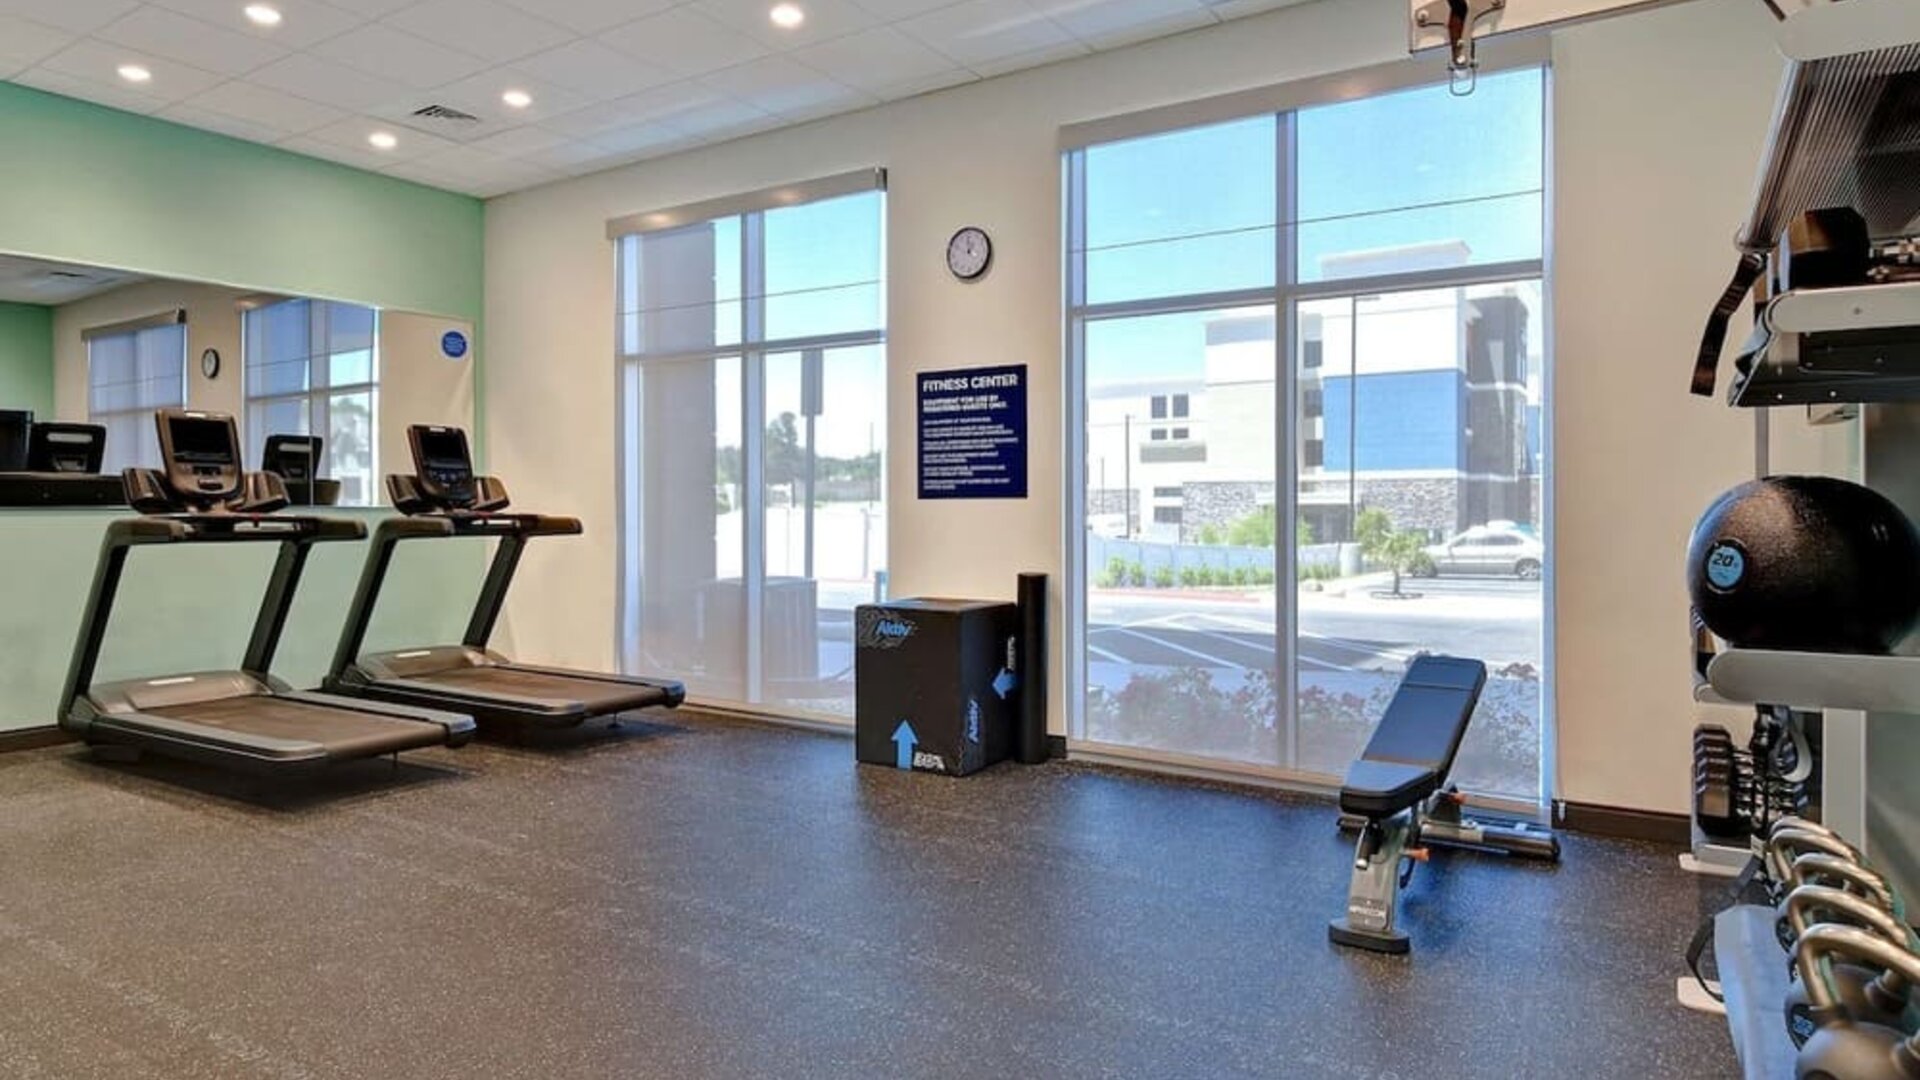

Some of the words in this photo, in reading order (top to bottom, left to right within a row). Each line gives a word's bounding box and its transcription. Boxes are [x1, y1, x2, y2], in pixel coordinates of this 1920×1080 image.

[923, 378, 968, 392] FITNESS
[971, 374, 1018, 388] CENTER
[1712, 553, 1734, 567] 20
